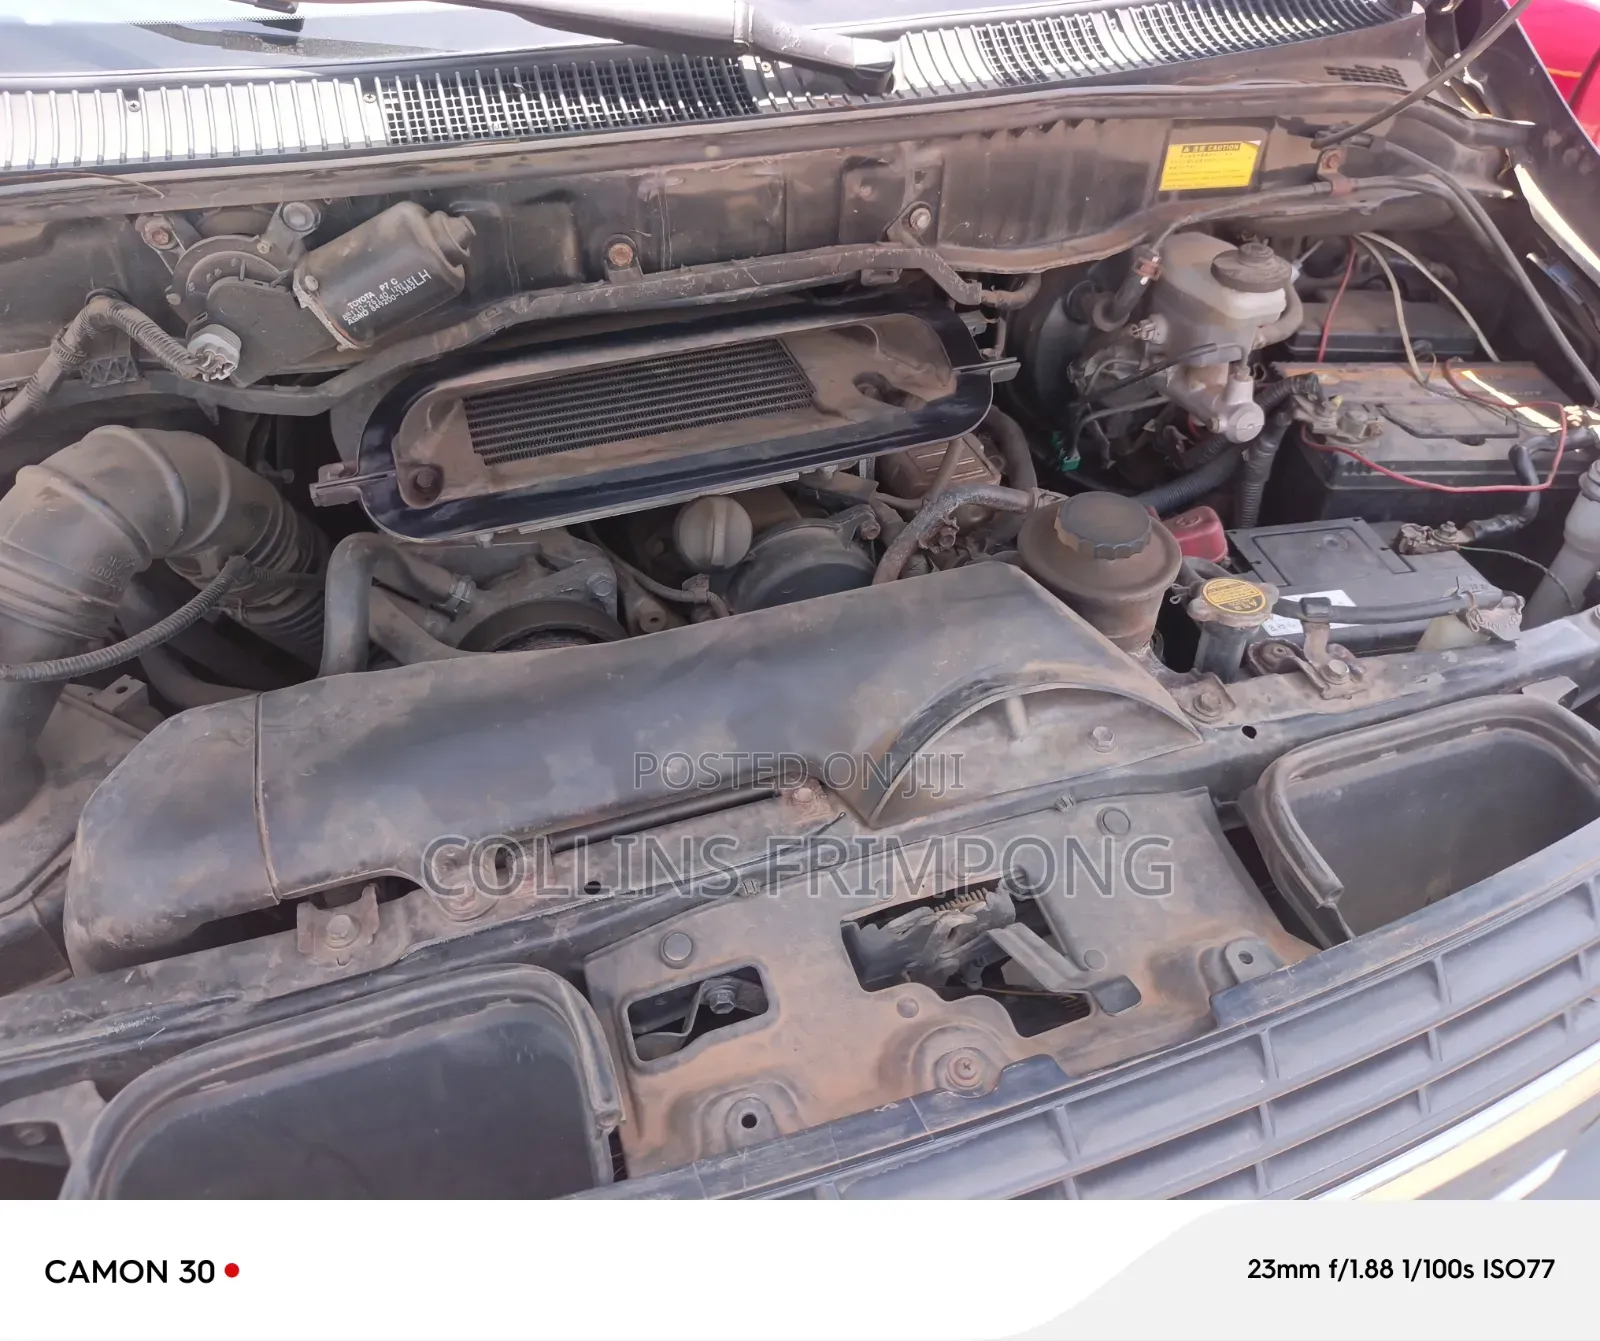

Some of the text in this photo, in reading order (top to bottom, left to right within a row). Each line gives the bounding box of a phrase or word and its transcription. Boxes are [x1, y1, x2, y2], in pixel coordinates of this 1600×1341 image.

[1207, 144, 1240, 152] CAUTION
[411, 269, 431, 286] LH
[347, 291, 376, 309] TOYOTA
[379, 282, 390, 292] P7
[347, 309, 369, 325] ASMO
